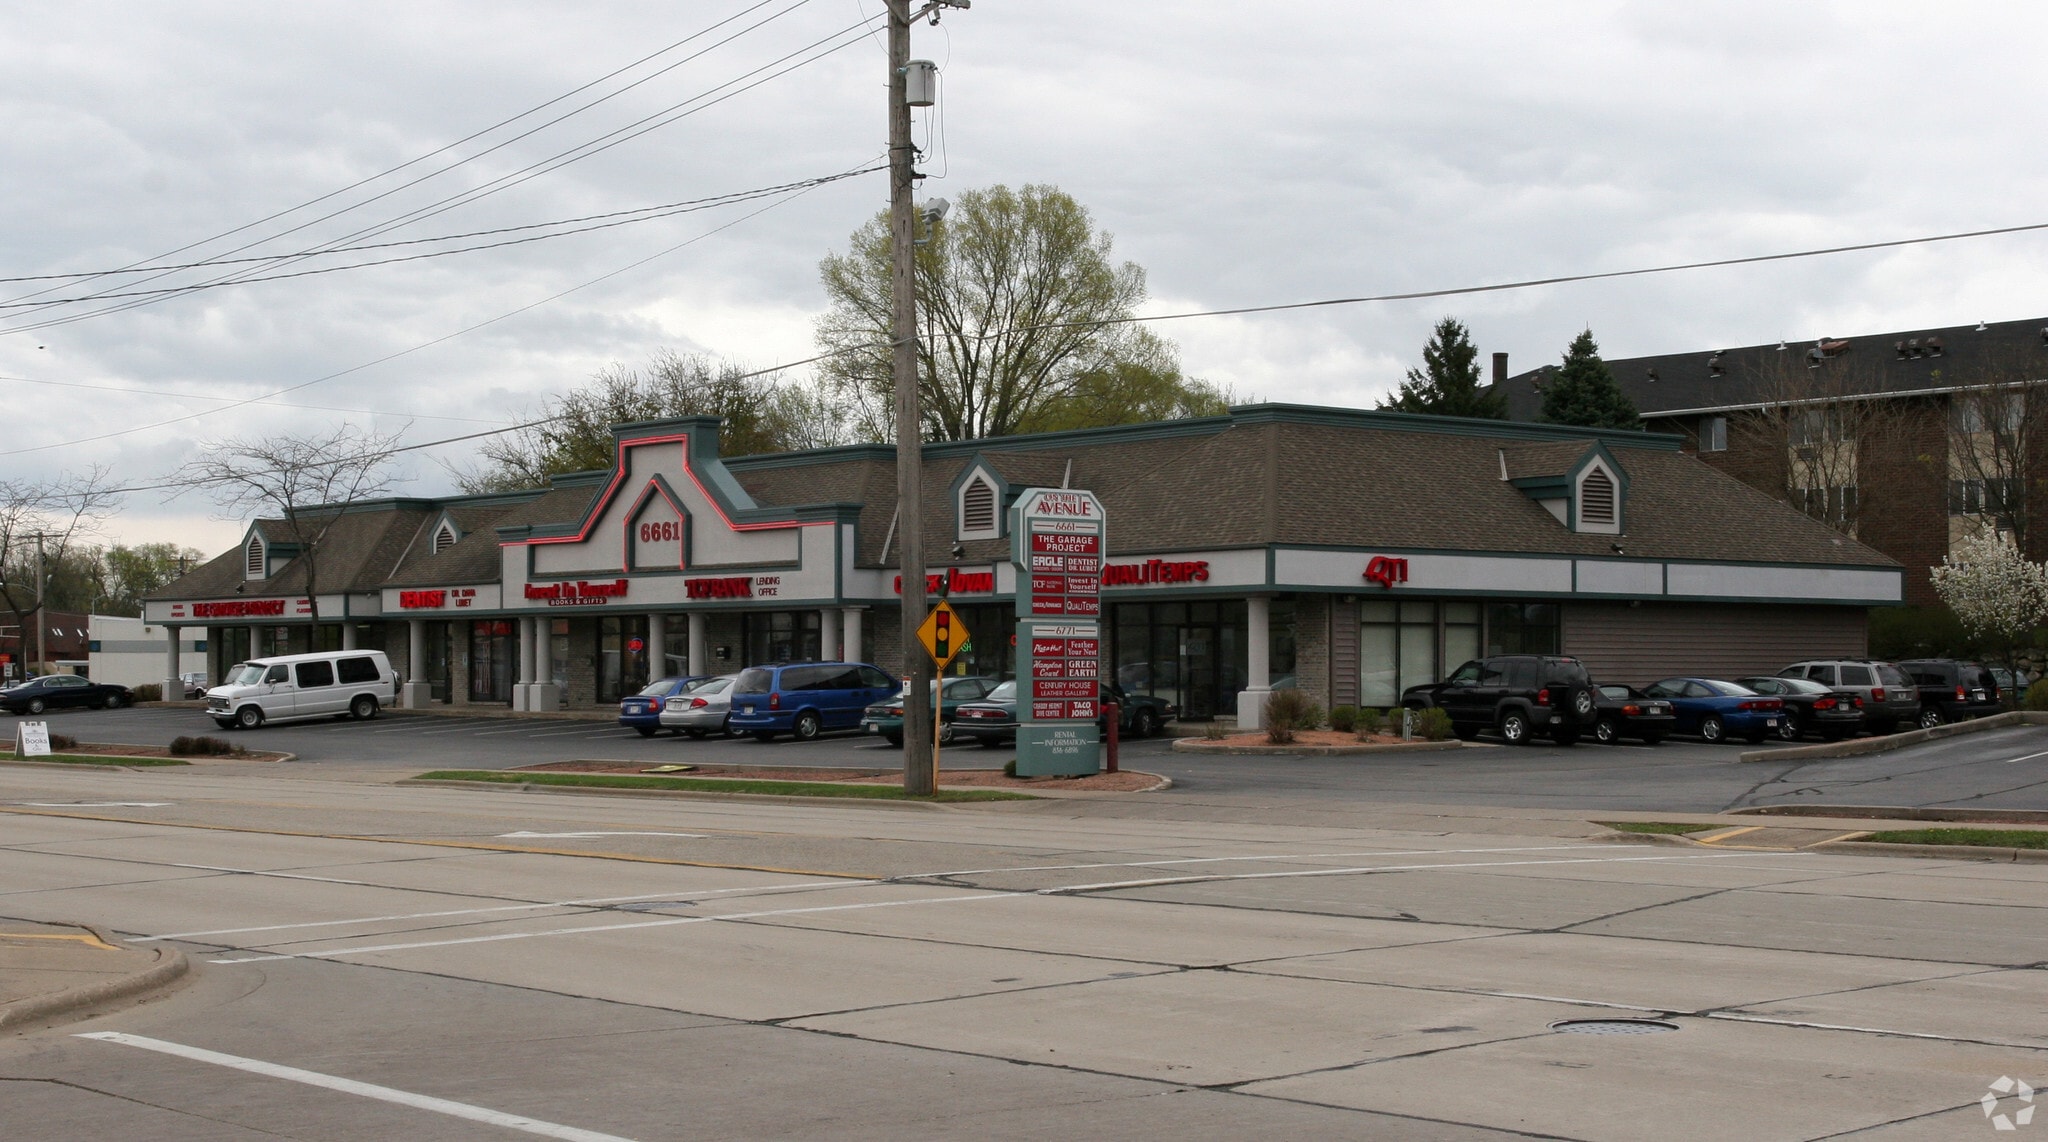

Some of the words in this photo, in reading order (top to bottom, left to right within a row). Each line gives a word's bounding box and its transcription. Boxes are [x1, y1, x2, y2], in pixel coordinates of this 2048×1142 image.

[1045, 493, 1058, 502] ON
[1062, 494, 1076, 502] THE
[1035, 501, 1091, 516] AVENUE
[1055, 522, 1075, 531] 6661
[640, 522, 680, 543] 6661
[1038, 535, 1055, 543] THE
[1057, 535, 1093, 545] GARAGE
[1046, 544, 1085, 552] PROJECT
[1032, 556, 1063, 567] EAGLE
[1067, 558, 1098, 566] DENTIST
[756, 576, 780, 585] LENDING
[1033, 580, 1045, 588] TCF
[711, 577, 753, 598] BANK
[758, 588, 777, 596] OFFICE
[400, 590, 447, 608] DENTIST
[550, 598, 573, 606] BOOKS
[582, 597, 603, 605] GIFTS
[1055, 626, 1075, 635] 6771
[1033, 660, 1062, 670] Hampton
[1068, 660, 1096, 668] GREEN
[1040, 668, 1059, 676] Court
[1069, 669, 1096, 677] EARTH
[1044, 738, 1087, 746] INFORMATION
